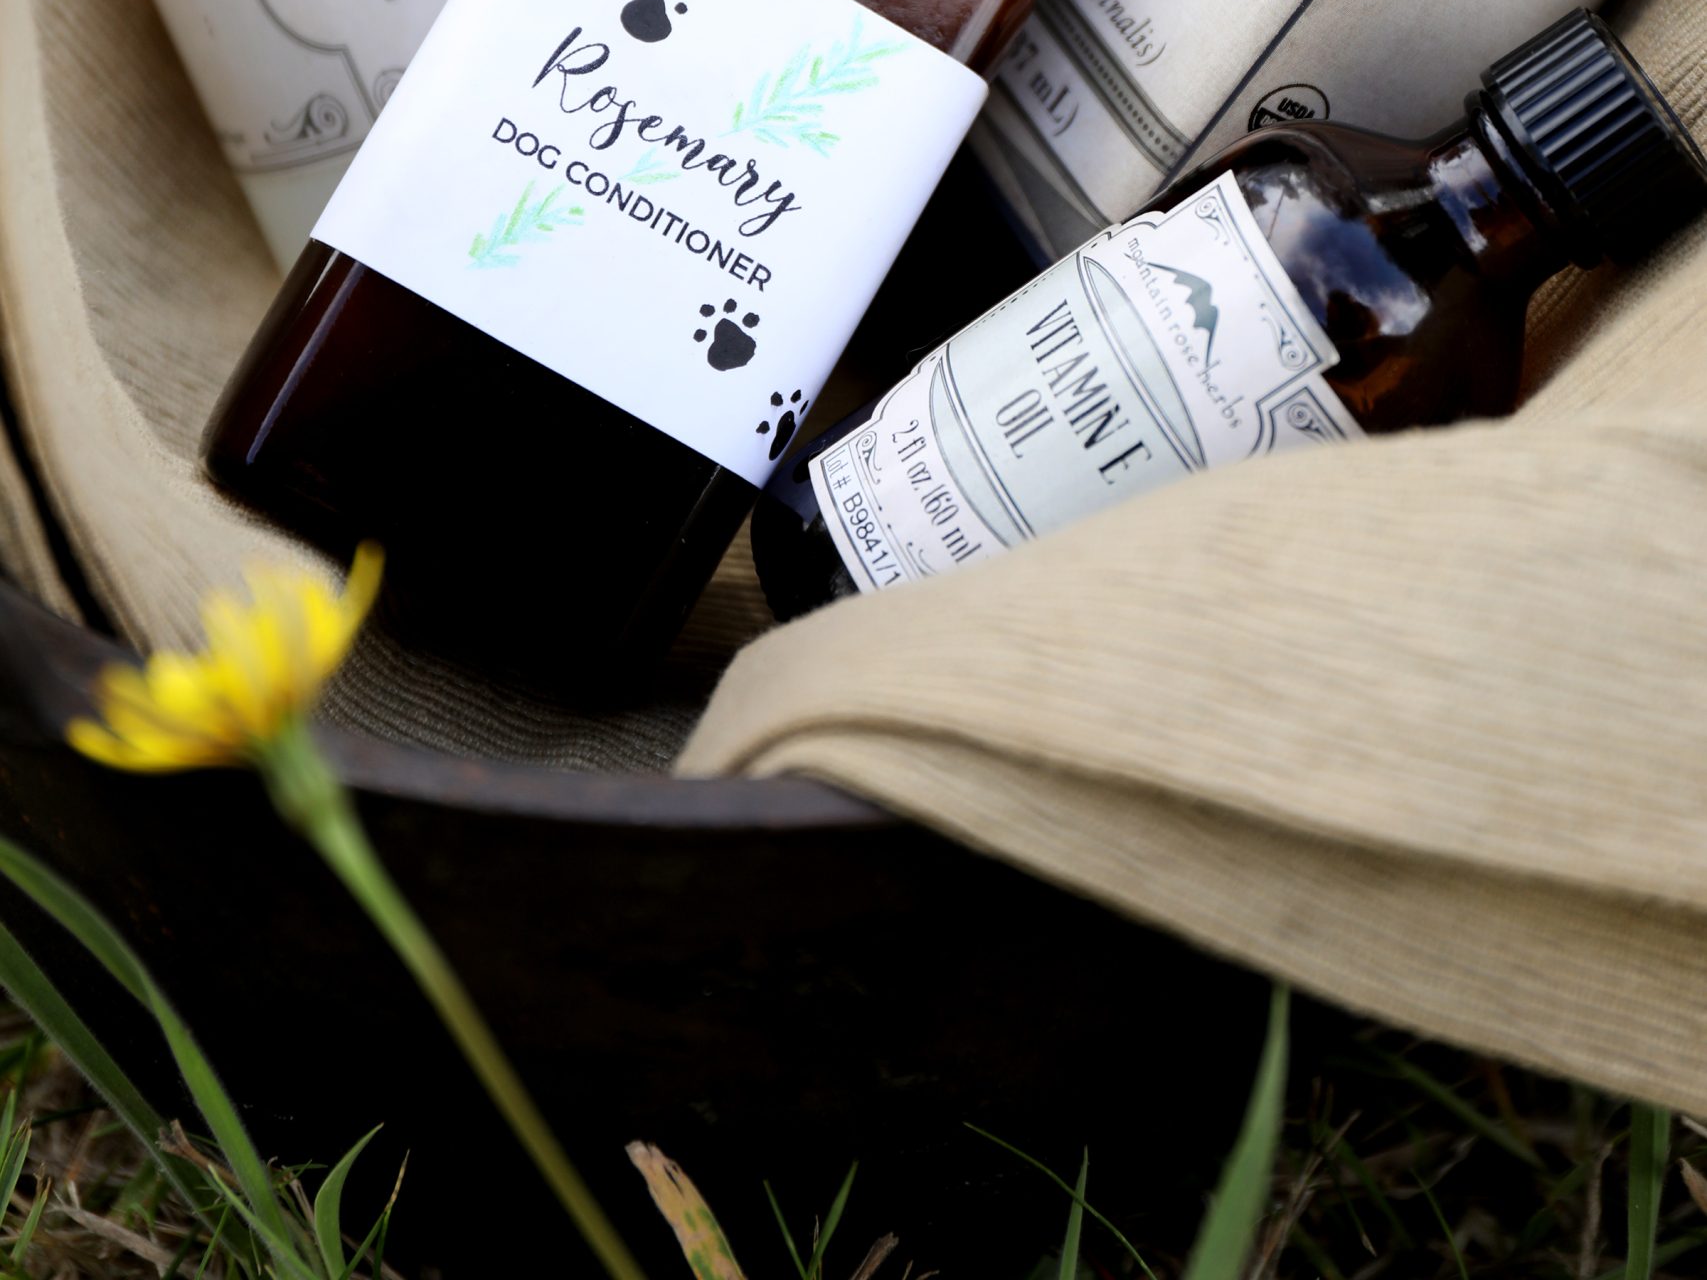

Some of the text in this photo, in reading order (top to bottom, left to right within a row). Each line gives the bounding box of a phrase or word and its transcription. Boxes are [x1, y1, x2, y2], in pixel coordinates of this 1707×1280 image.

[532, 26, 802, 237] Rosemary
[1028, 75, 1080, 137] mL)
[491, 117, 773, 292] DOG CONDITIONER
[891, 419, 920, 444] 2
[995, 388, 1055, 460] OIL
[1026, 298, 1153, 486] VITAMIN E
[1168, 323, 1200, 367] rose
[1196, 358, 1245, 430] herbs
[832, 474, 852, 490] #
[842, 491, 901, 587] B9841/1
